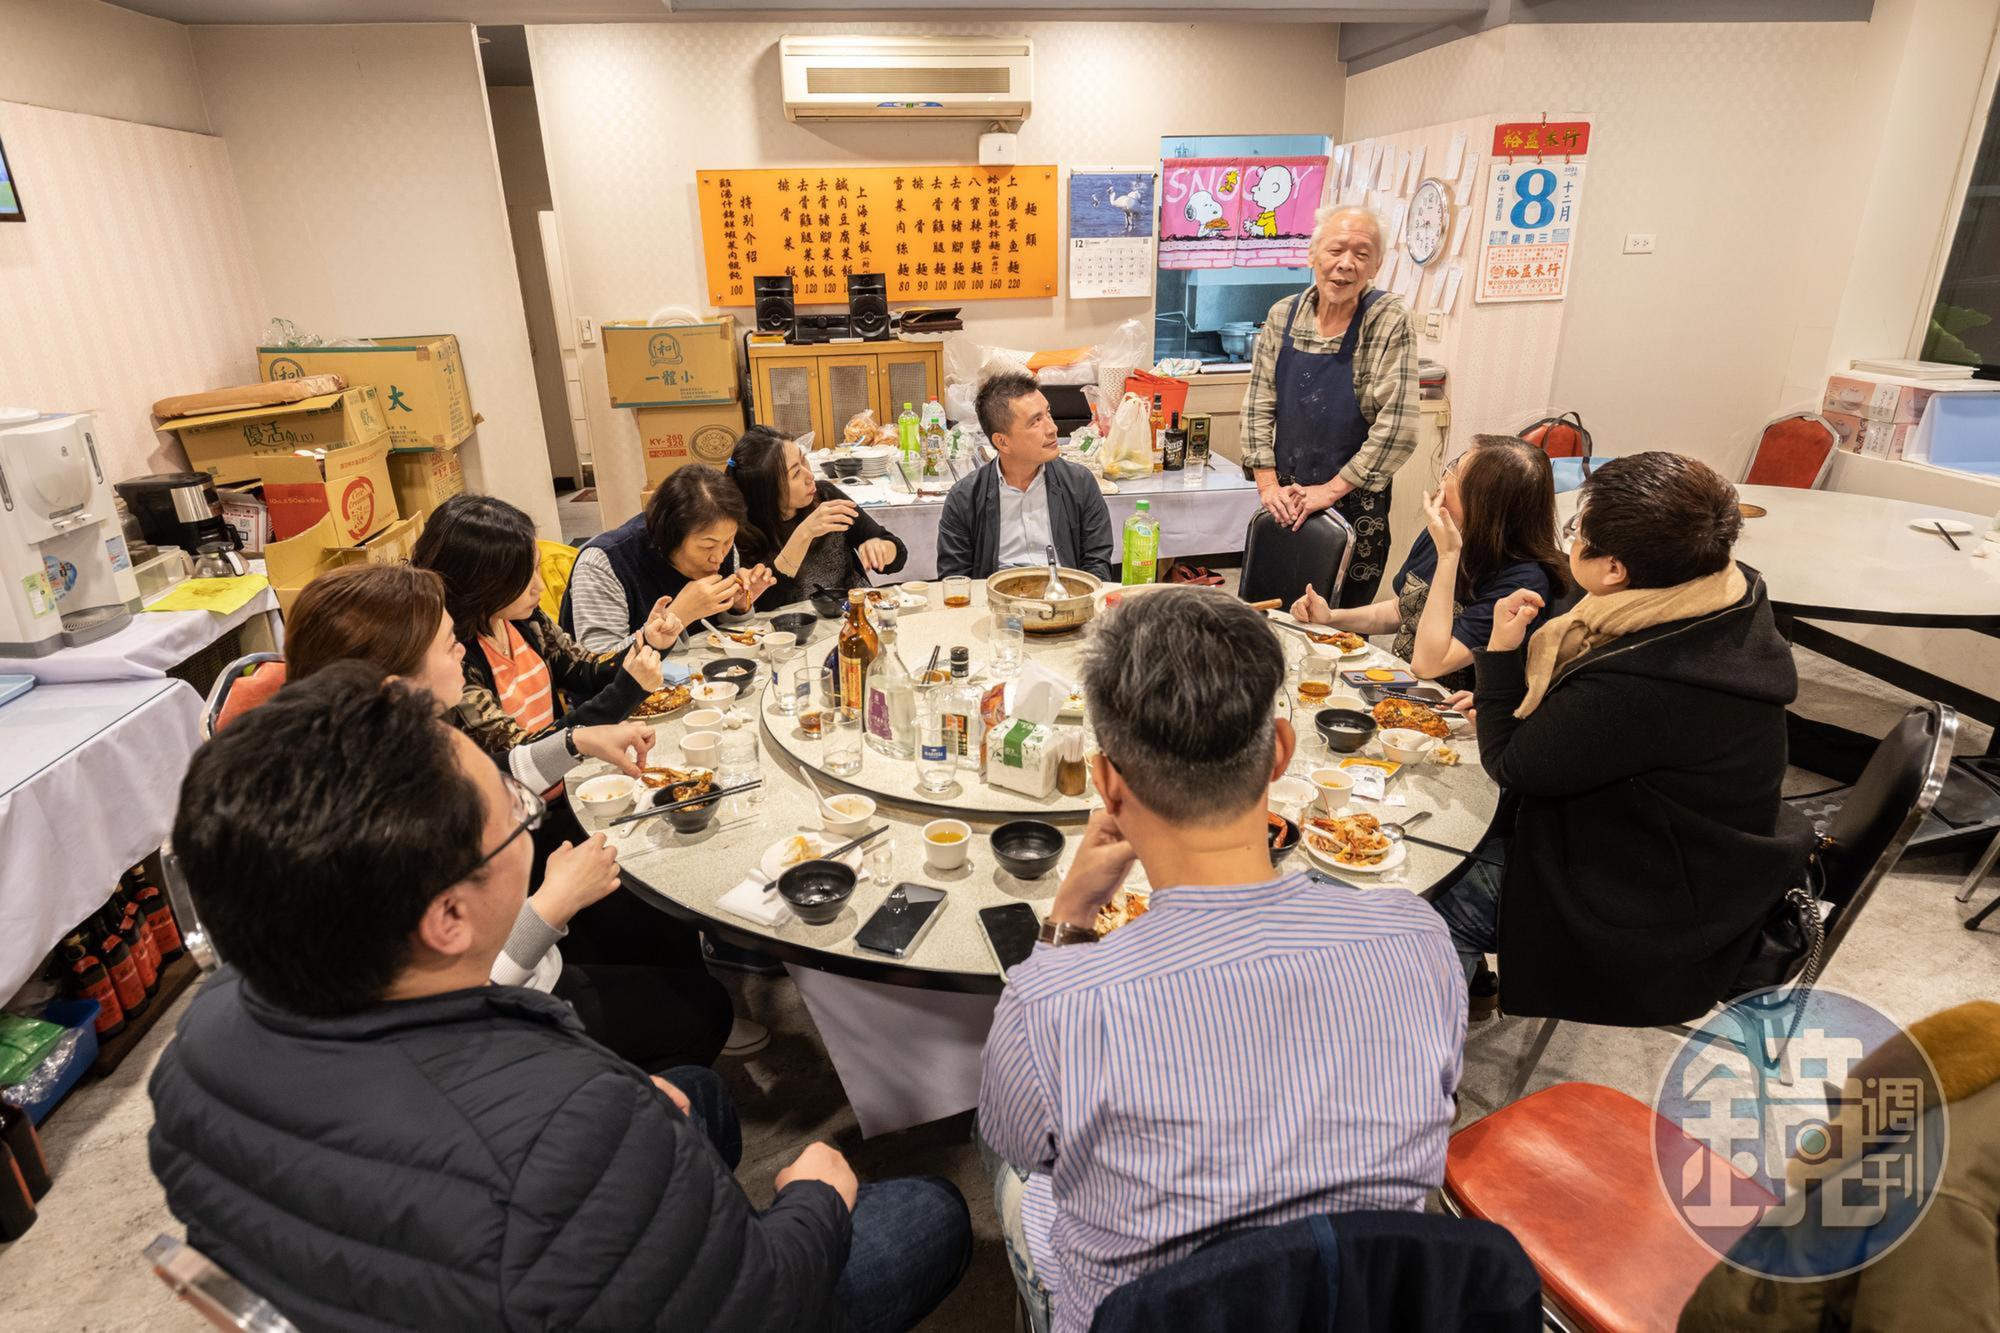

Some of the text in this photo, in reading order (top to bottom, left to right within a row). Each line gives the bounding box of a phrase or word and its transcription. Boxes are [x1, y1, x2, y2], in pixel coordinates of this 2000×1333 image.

[1165, 165, 1314, 203] SNOOY
[1510, 168, 1558, 229] 8
[1559, 181, 1574, 222] 十二月
[740, 195, 758, 263] 特別介紹
[777, 178, 798, 278] 排骨菜飯
[797, 178, 818, 294] 去骨雞腿菜飯 120
[816, 178, 837, 293] 去骨豬腳菜飯 120
[856, 186, 872, 254] 上海菜飯
[893, 176, 910, 292] 雪菜肉絲麵 80
[911, 177, 928, 291] 排骨麵 90
[931, 176, 948, 291] 去骨雞腿麵 100
[950, 176, 966, 290] 去骨豬腳麵 100
[1006, 175, 1021, 289] 上湯黃魚麵 220
[1024, 202, 1038, 247] 麵類
[1075, 239, 1084, 248] 12
[1511, 233, 1549, 244] 星期三
[730, 285, 743, 296] 100
[971, 279, 984, 289] 100
[989, 279, 1002, 289] 160
[388, 384, 413, 412] 大
[242, 420, 285, 447] 優活
